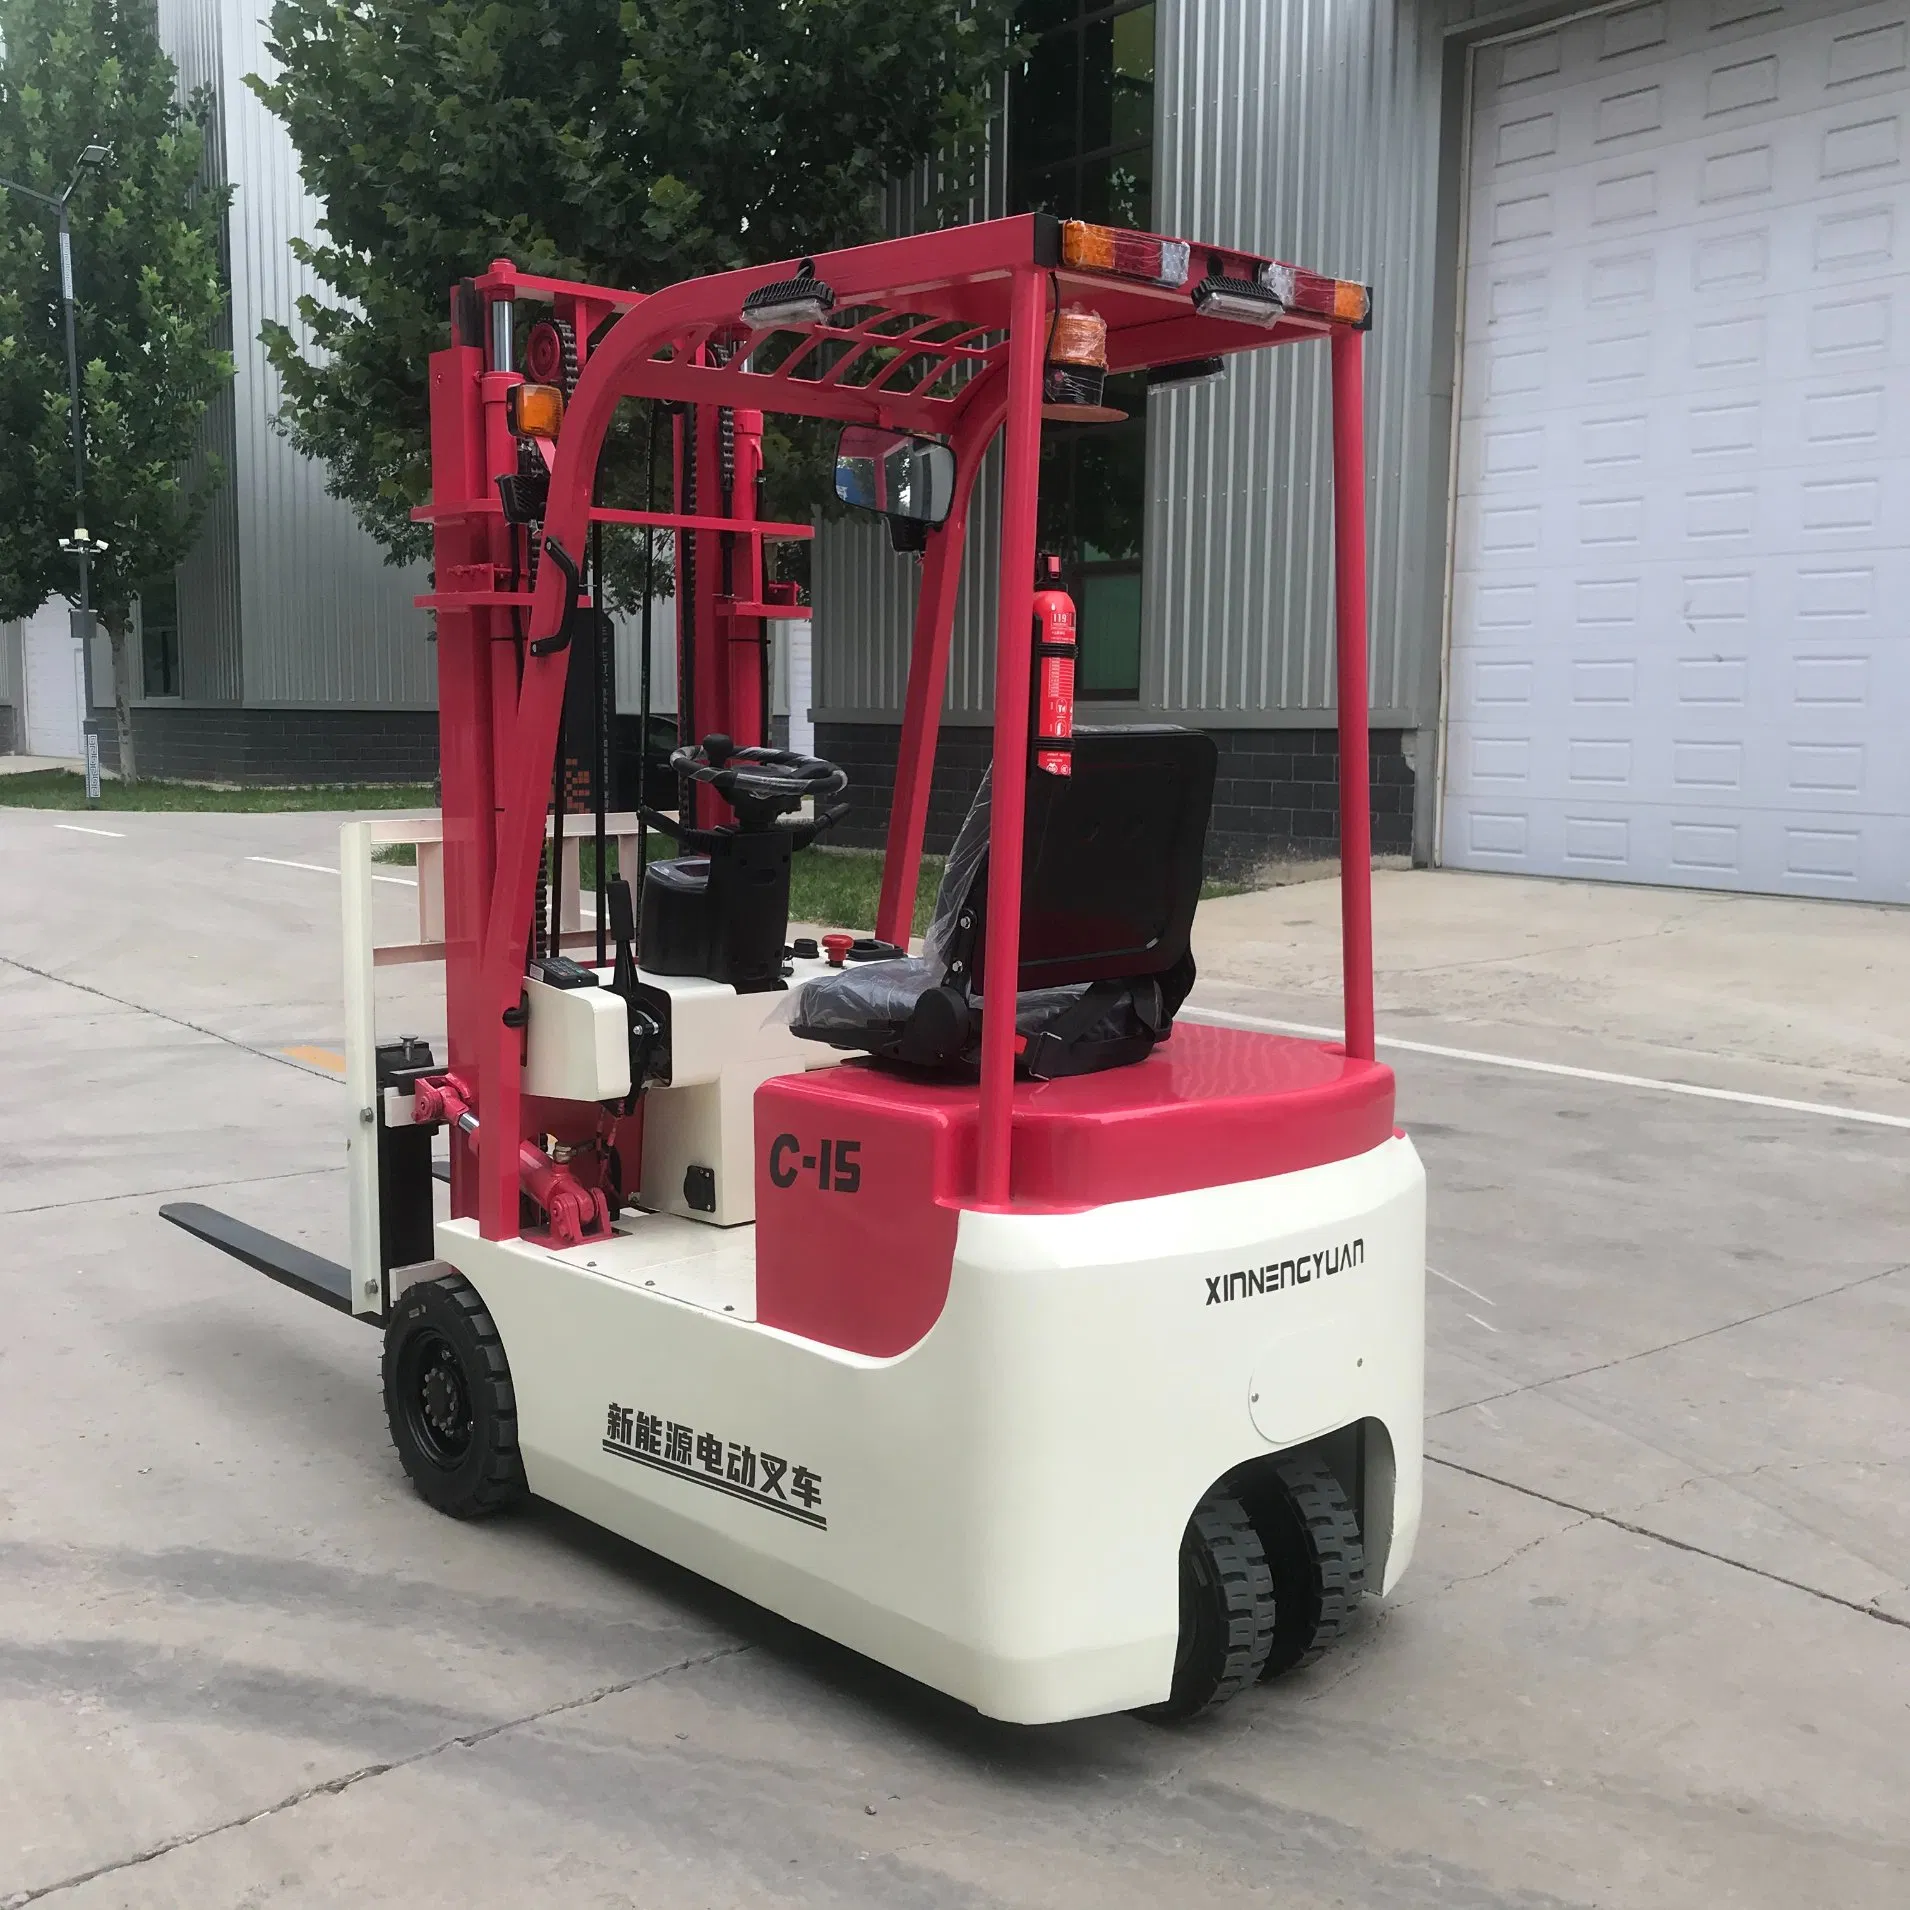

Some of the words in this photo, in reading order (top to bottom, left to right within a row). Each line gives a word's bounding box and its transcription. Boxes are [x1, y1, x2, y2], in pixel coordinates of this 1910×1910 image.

[769, 1133, 861, 1193] C-15
[1205, 1238, 1364, 1306] XINNENGYUAN
[607, 1402, 822, 1509] 新能源电动叉车
